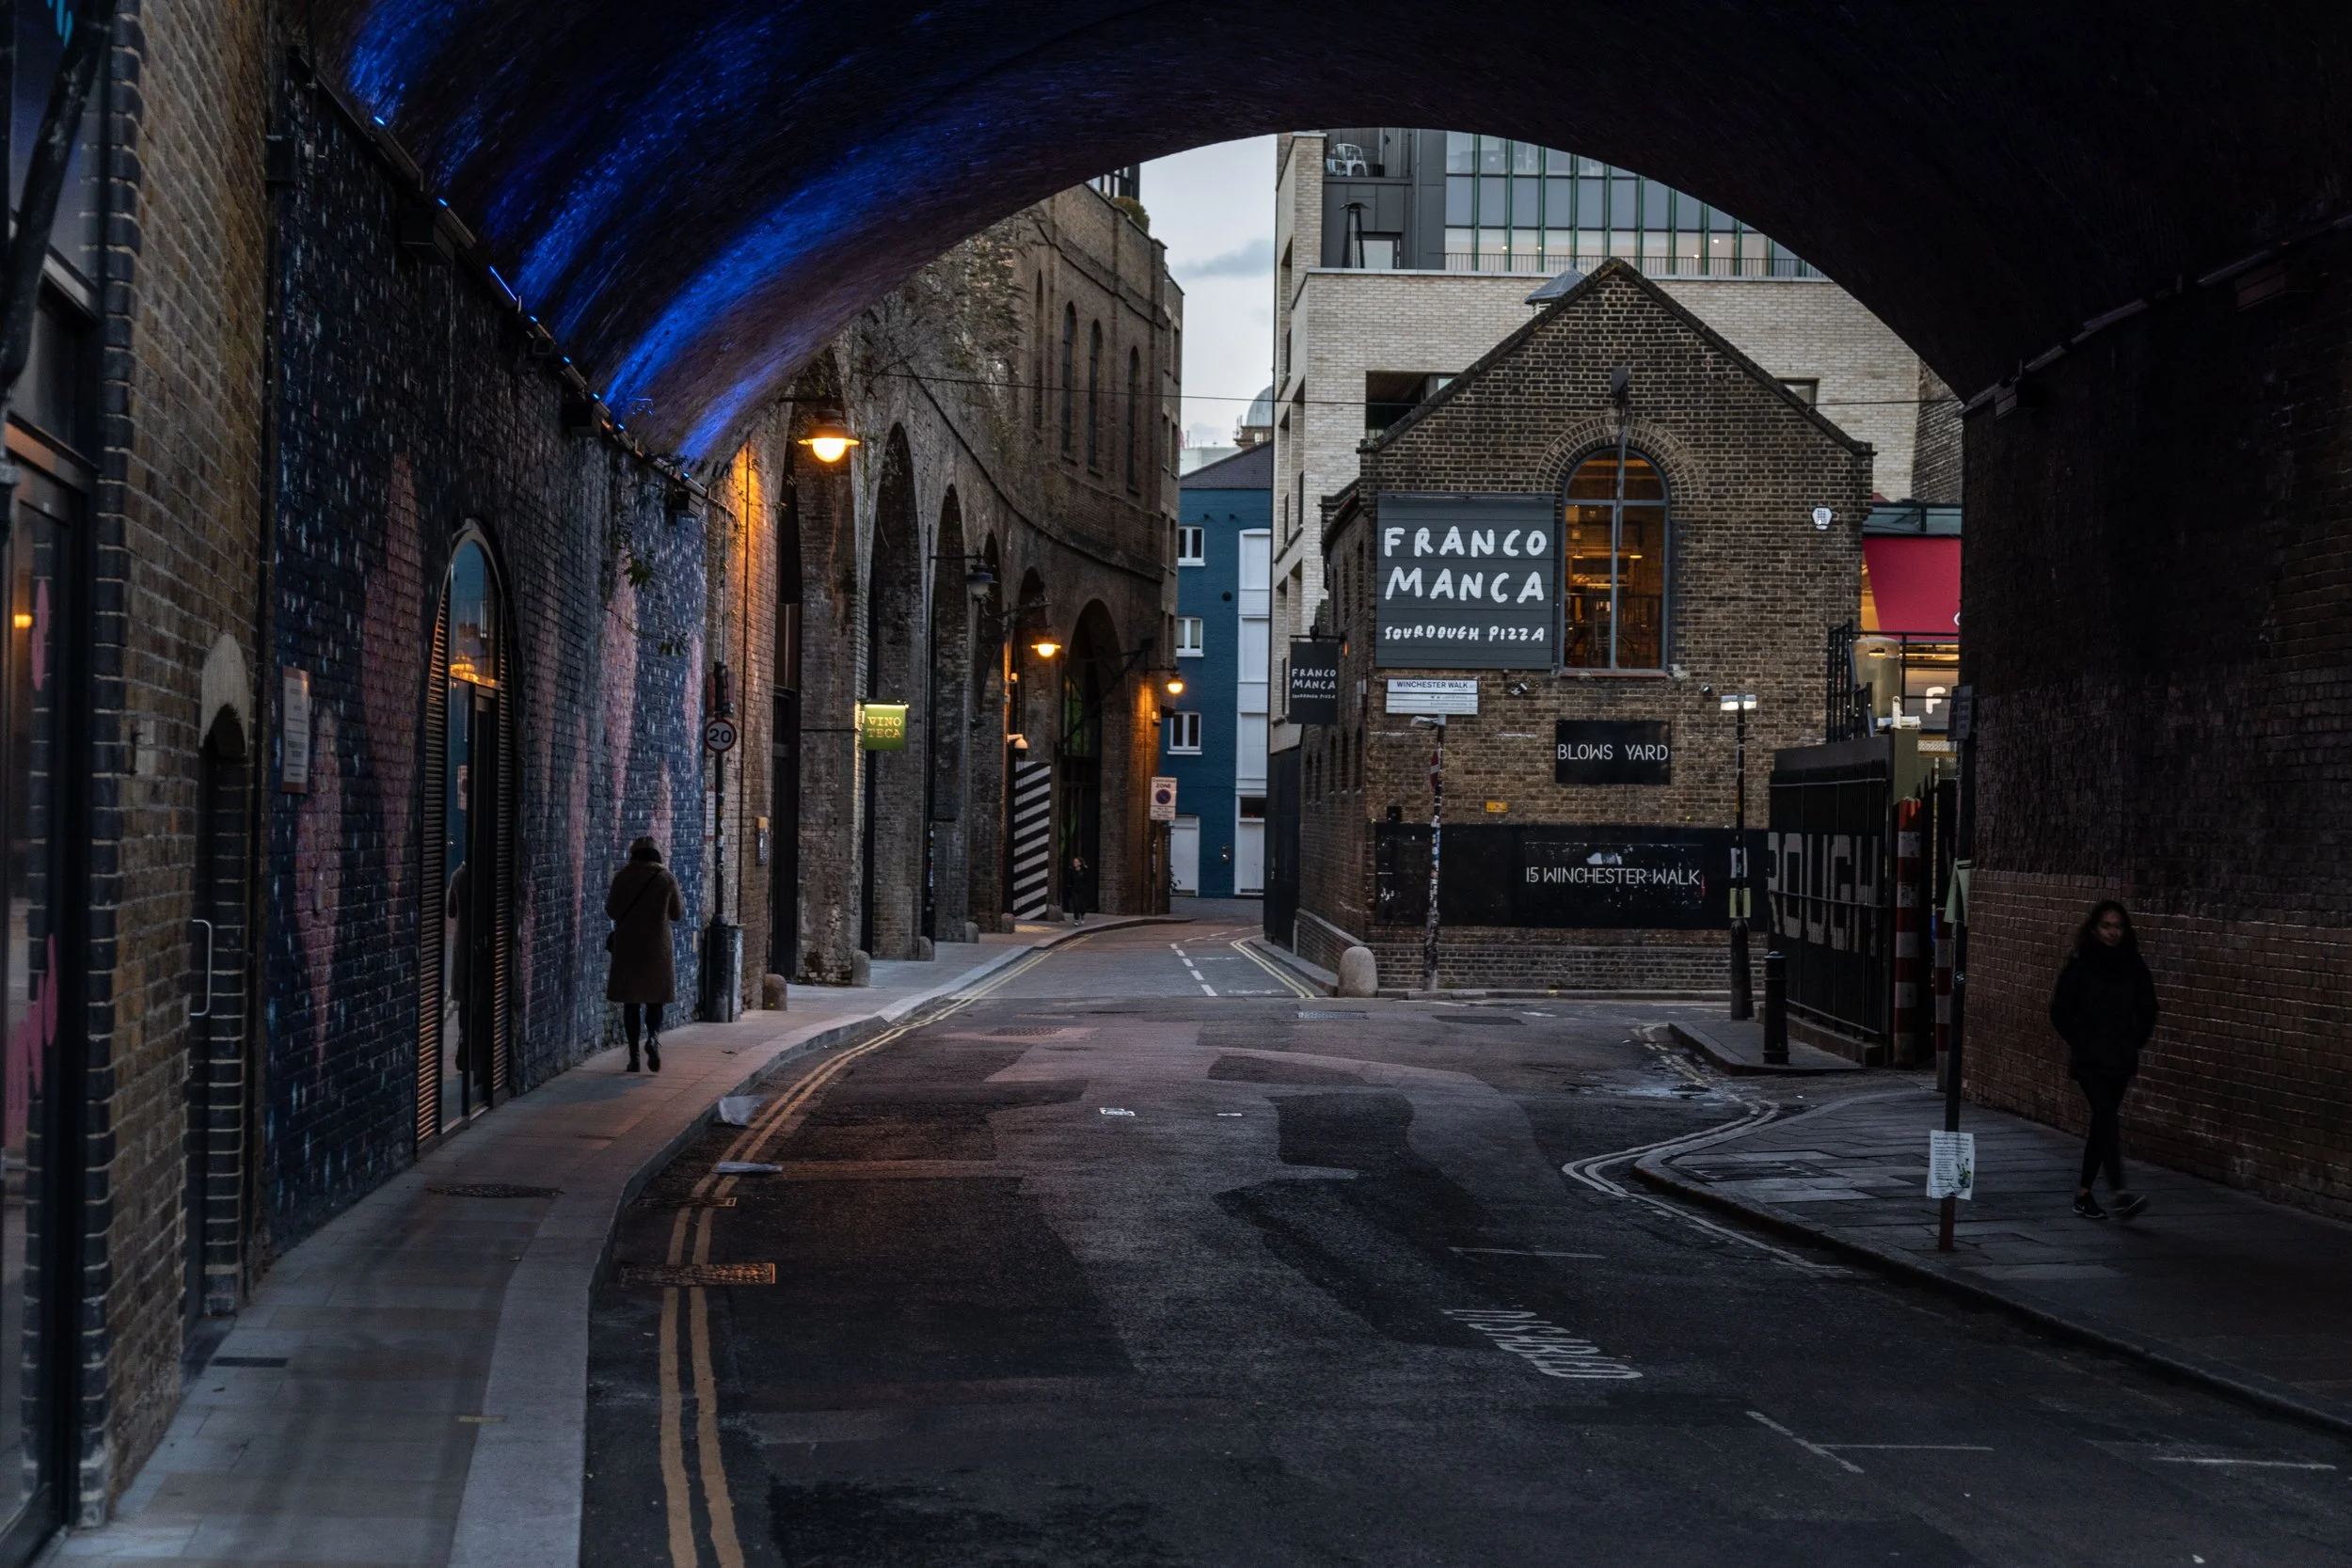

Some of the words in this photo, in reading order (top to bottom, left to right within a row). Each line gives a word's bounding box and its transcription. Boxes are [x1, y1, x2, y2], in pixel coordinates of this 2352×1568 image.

[1384, 526, 1548, 558] FRANCO
[1385, 566, 1545, 604] MANCA
[1385, 625, 1479, 641] SOURDOUGH
[1488, 626, 1545, 642] PIZZA
[1292, 668, 1337, 677] FRANCO
[1292, 679, 1336, 689] MANCA
[867, 716, 902, 726] VINO
[708, 728, 732, 743] 20
[866, 728, 901, 738] TECA
[1557, 743, 1613, 761] BLOWS
[1625, 744, 1669, 762] YARD
[1526, 866, 1539, 883] 15
[1543, 866, 1646, 884] WINCHESTER
[1653, 869, 1700, 885] WALK
[1439, 1308, 1644, 1380] DISABLED
